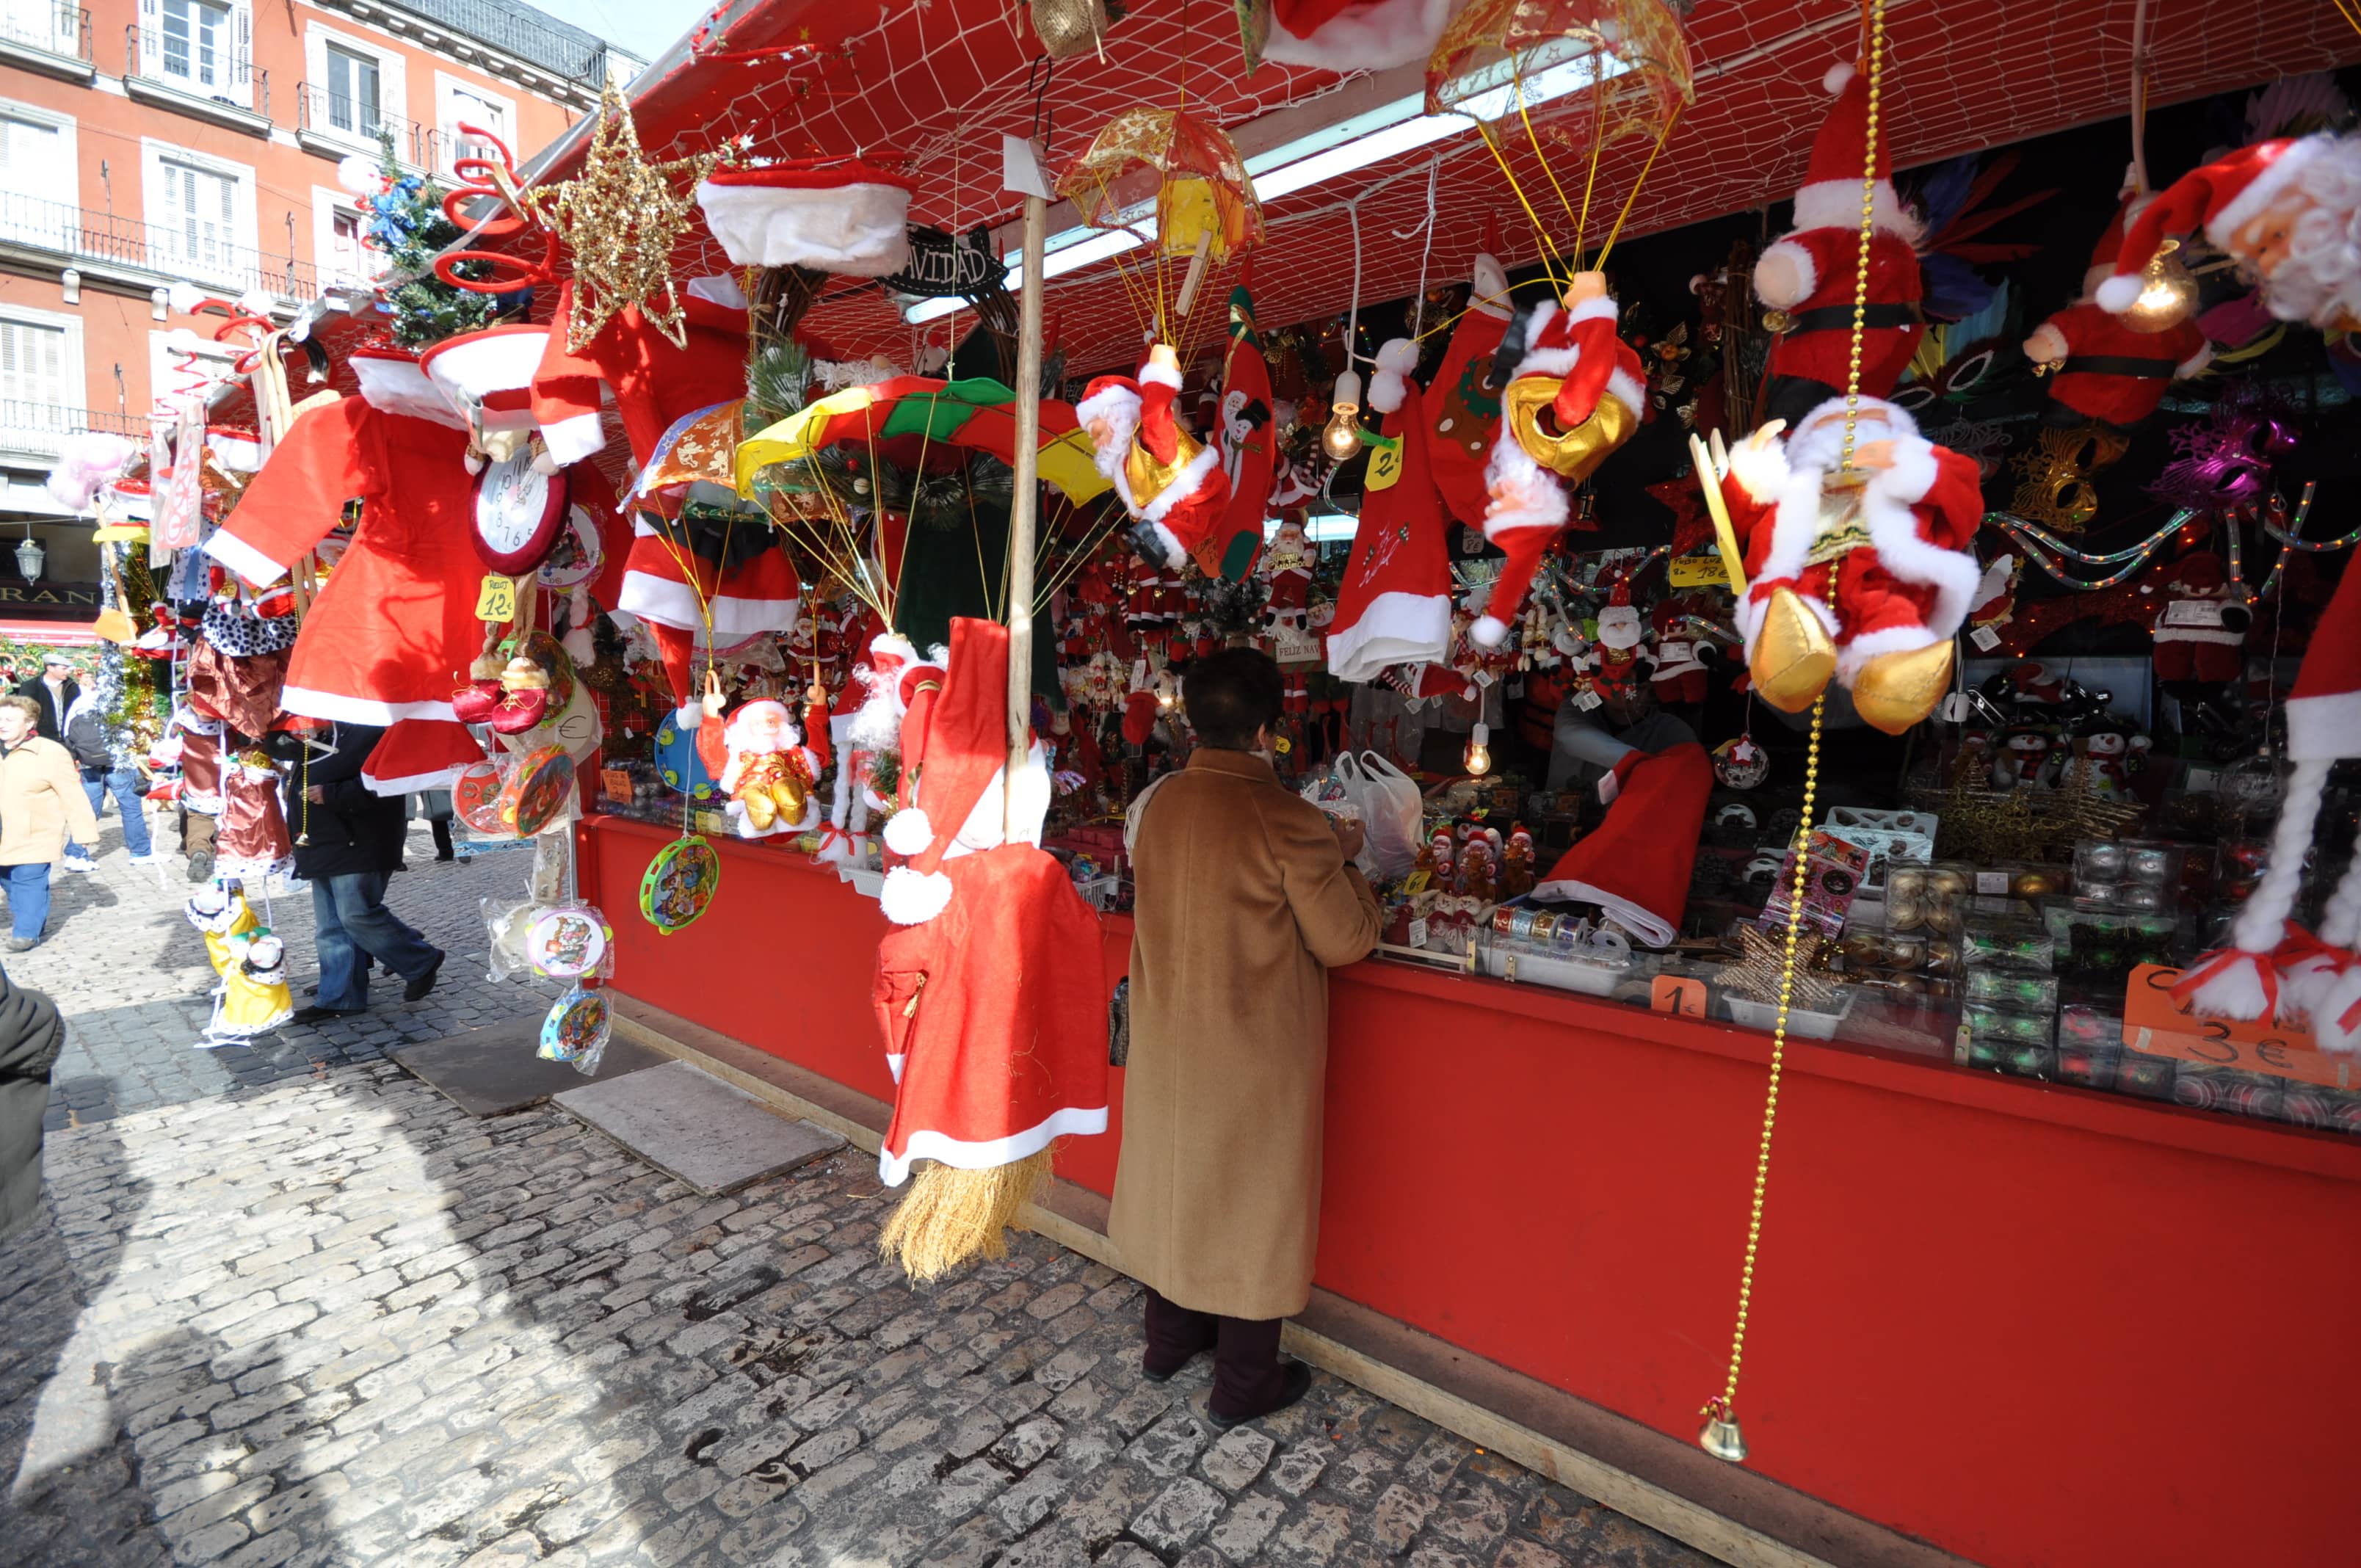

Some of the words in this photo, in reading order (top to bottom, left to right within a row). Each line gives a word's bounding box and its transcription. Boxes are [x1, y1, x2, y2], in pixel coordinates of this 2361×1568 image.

[501, 474, 512, 490] 10
[504, 526, 510, 542] 7
[512, 531, 521, 547] 6
[1279, 646, 1302, 657] FELIZ
